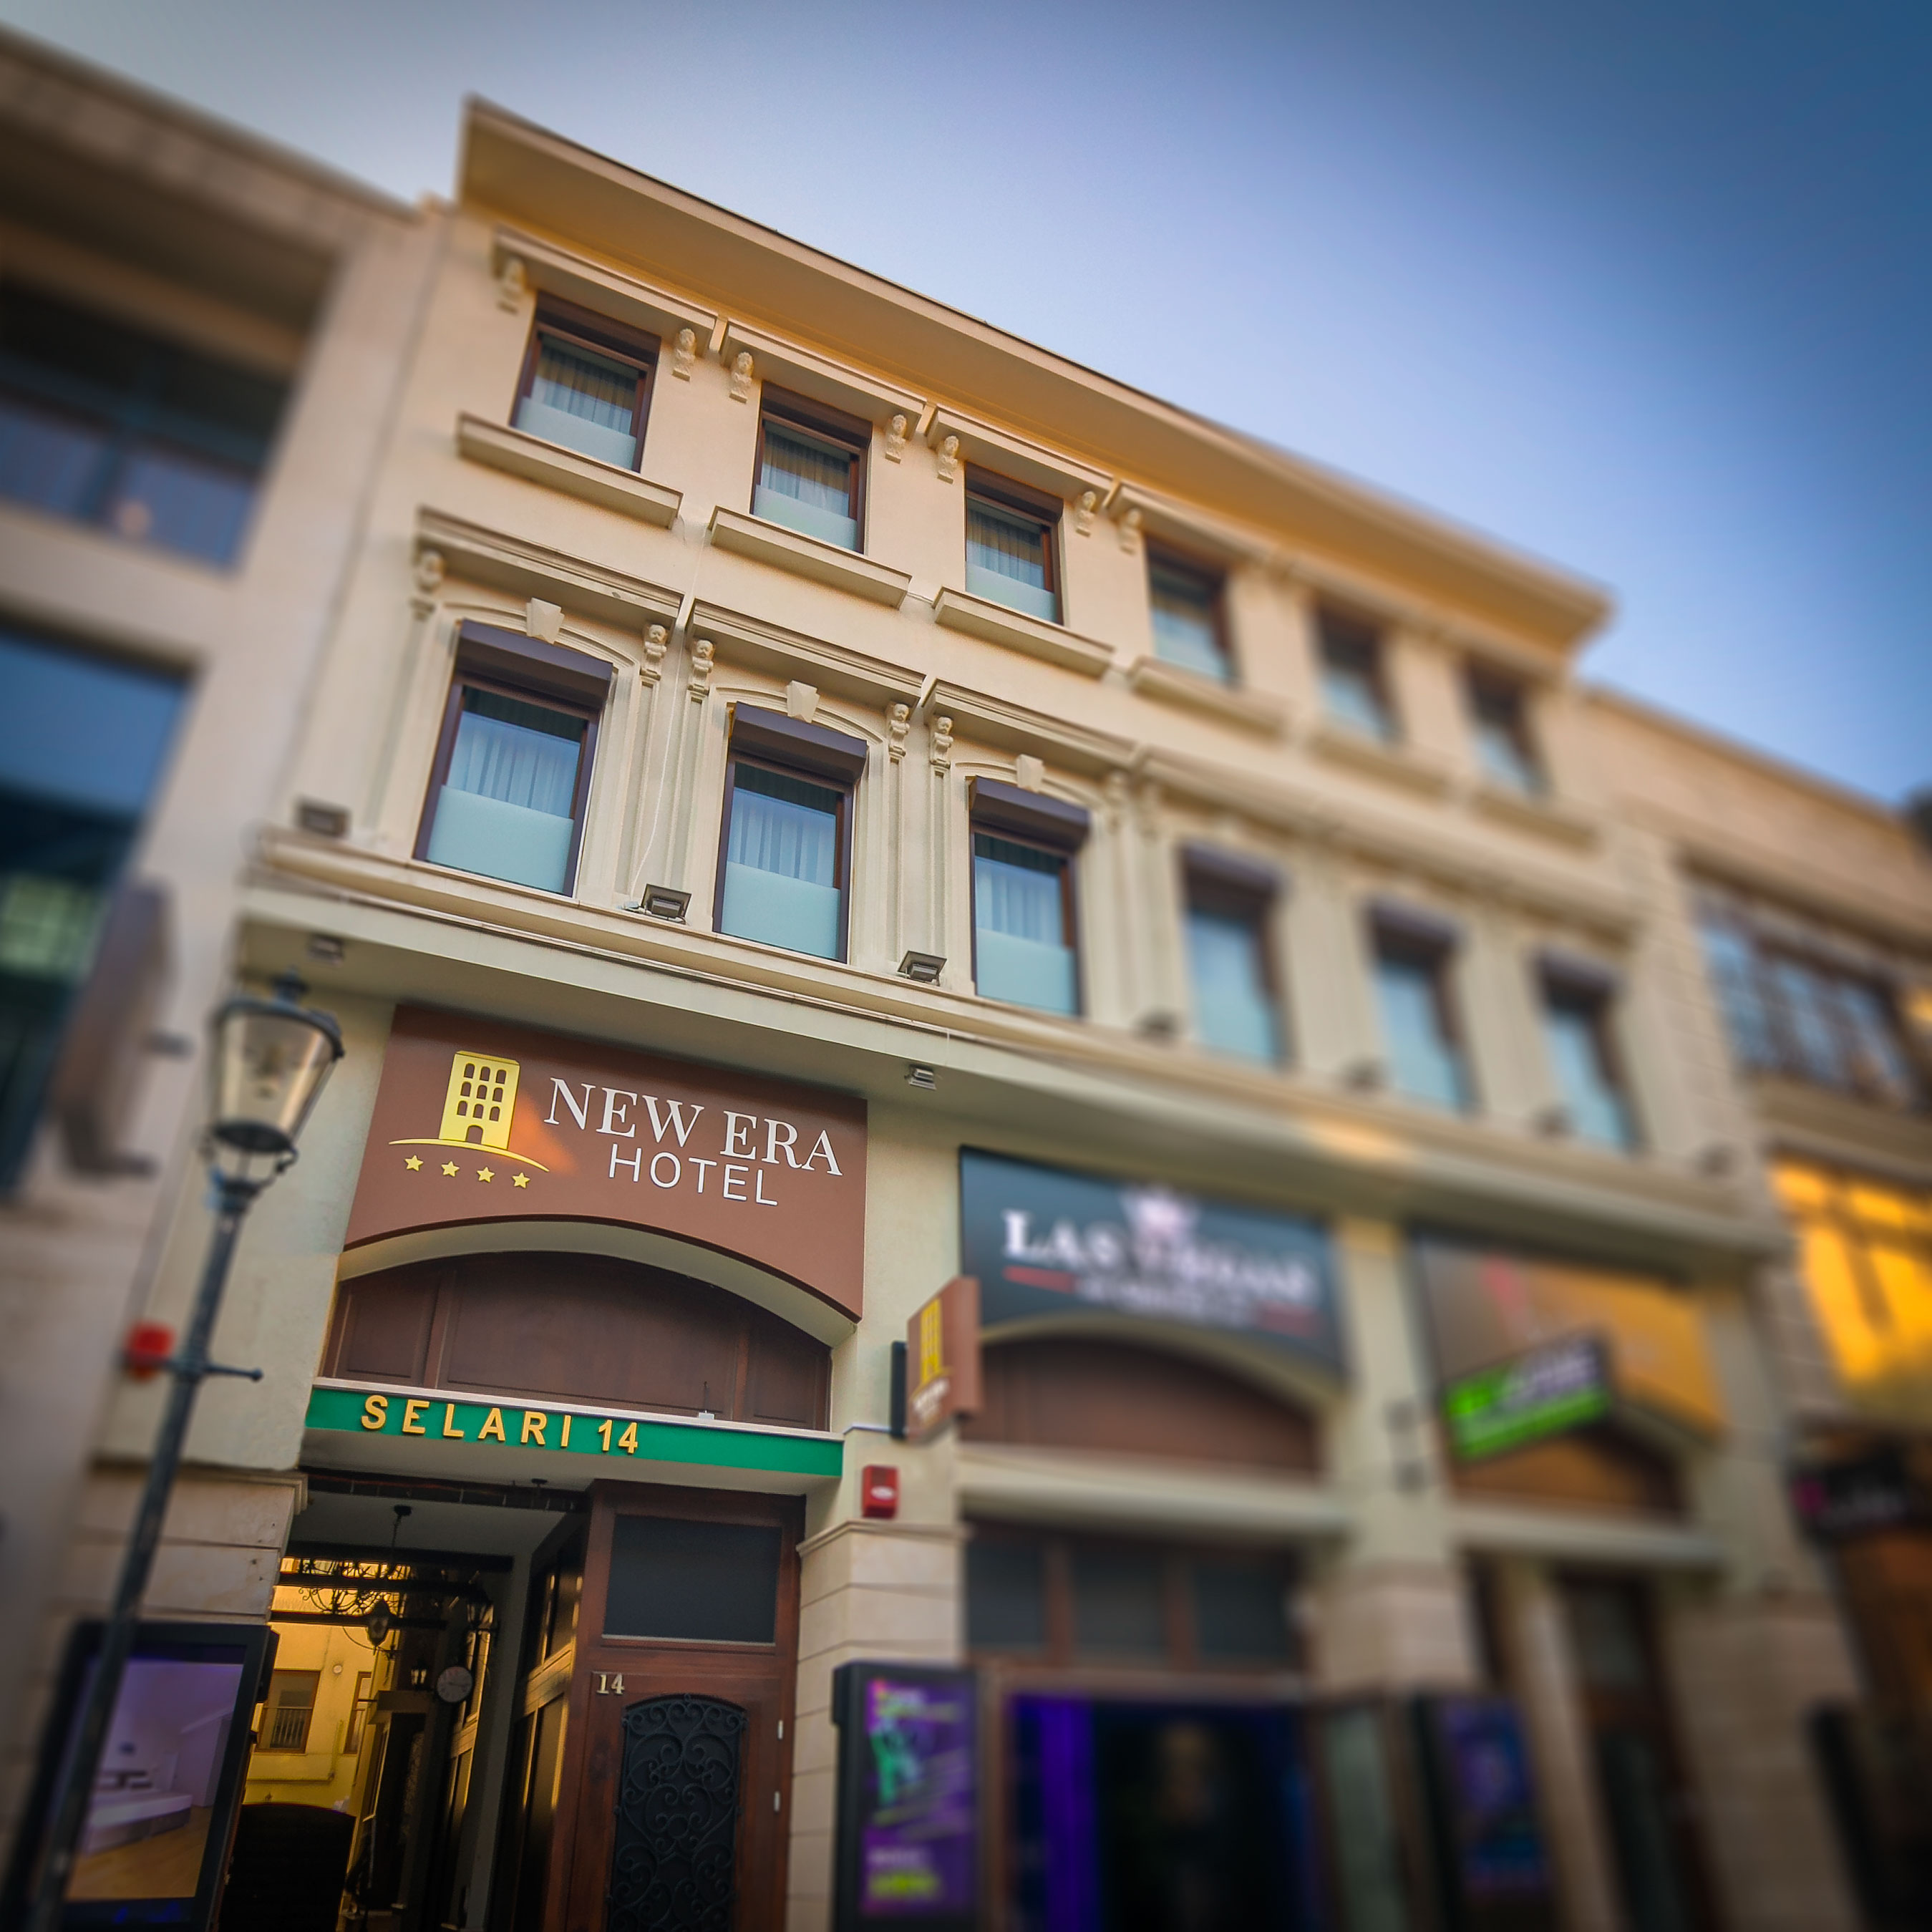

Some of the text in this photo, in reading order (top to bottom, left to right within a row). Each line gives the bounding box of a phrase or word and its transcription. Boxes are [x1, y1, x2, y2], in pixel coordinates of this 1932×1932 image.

[543, 1077, 844, 1177] NEW ERA
[608, 1142, 779, 1207] HOTEL
[360, 1394, 639, 1455] SELARI 14
[596, 1674, 624, 1694] 14
